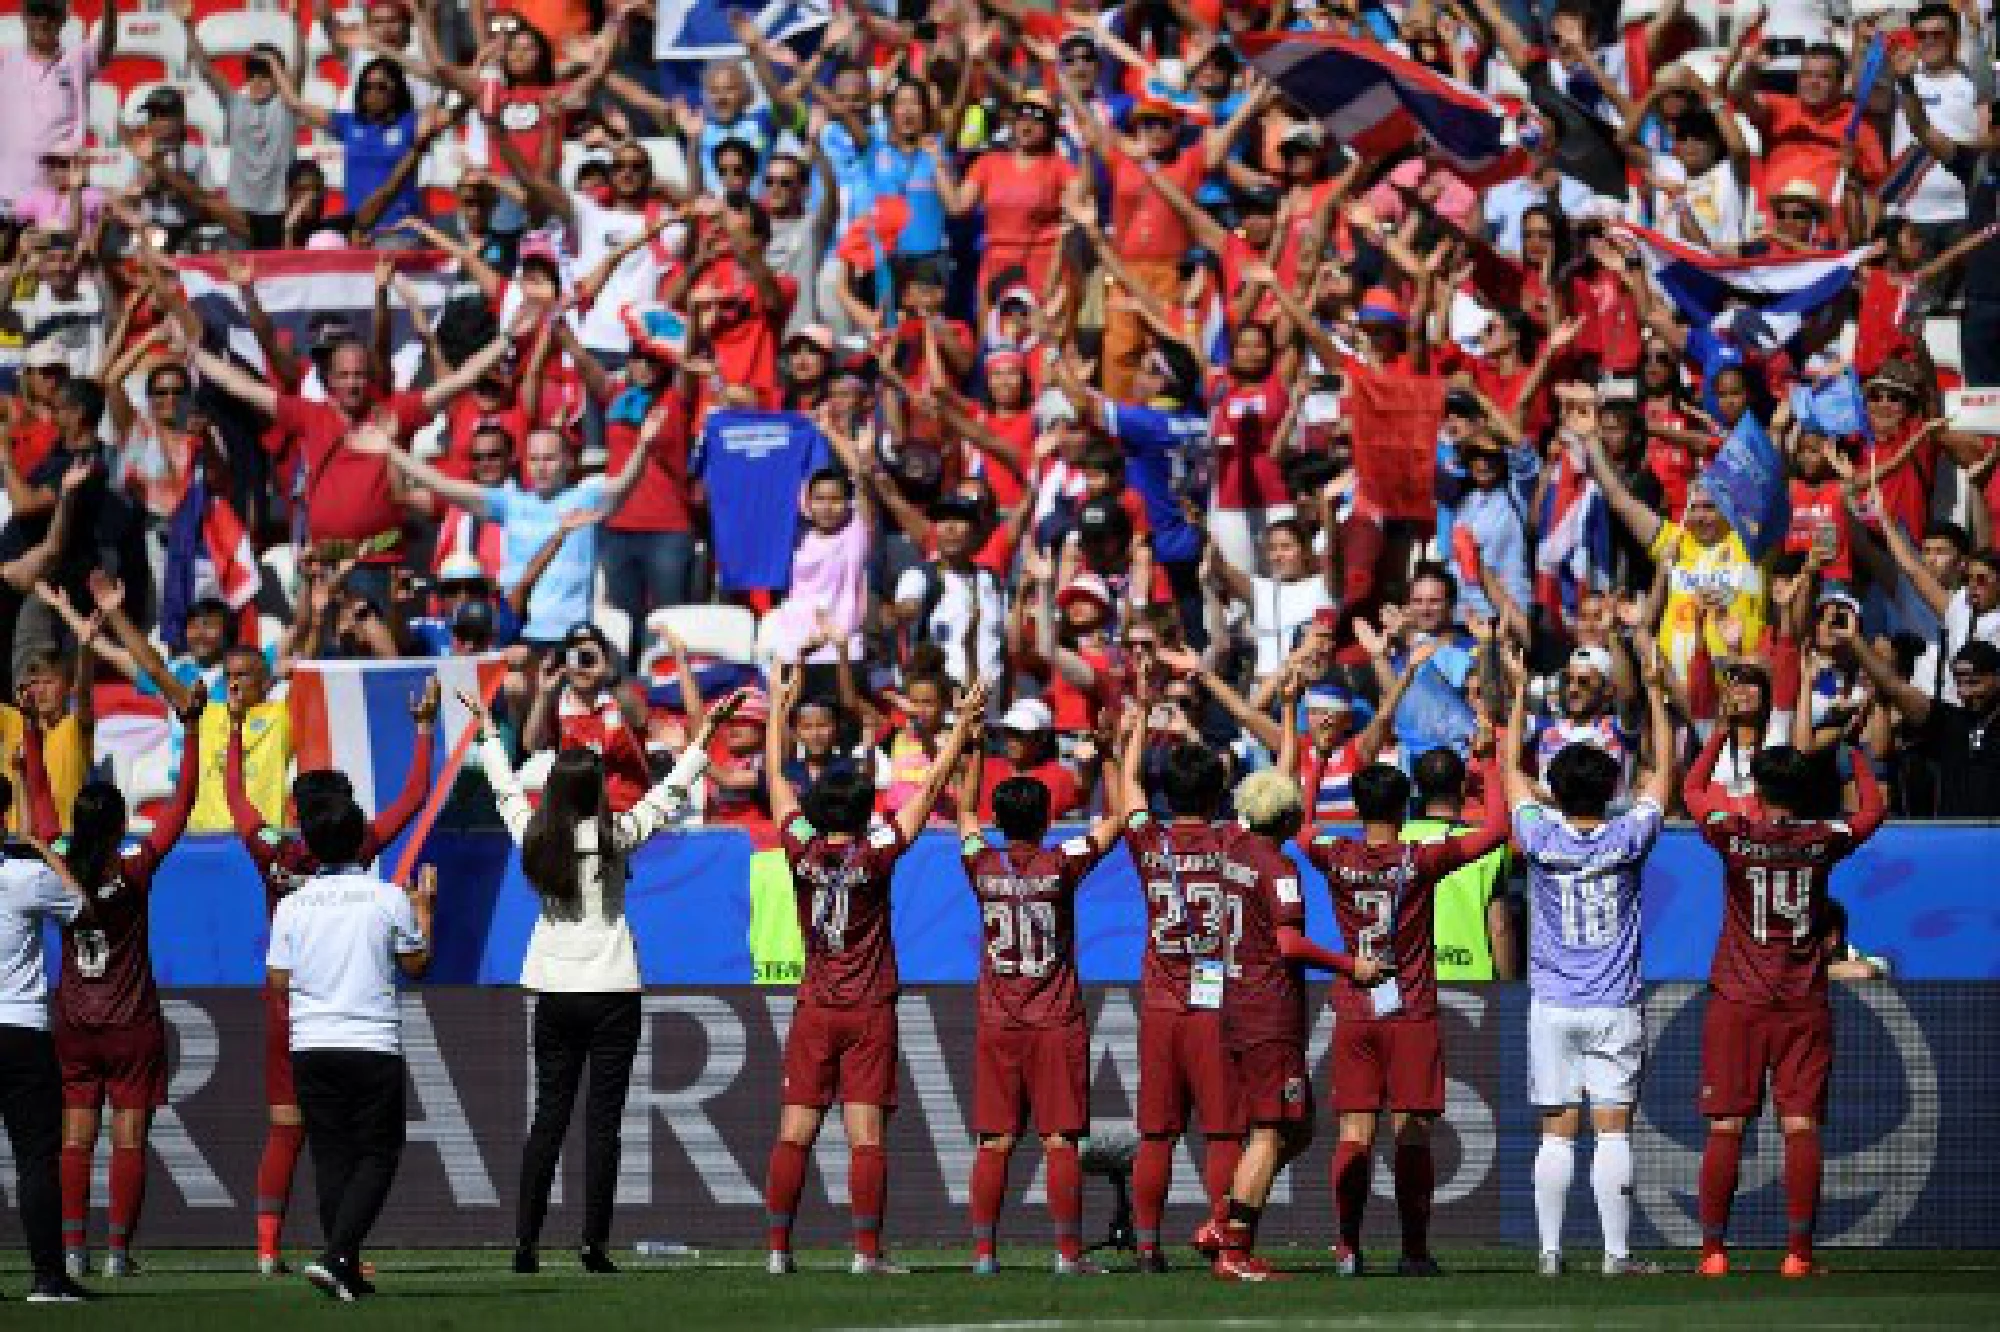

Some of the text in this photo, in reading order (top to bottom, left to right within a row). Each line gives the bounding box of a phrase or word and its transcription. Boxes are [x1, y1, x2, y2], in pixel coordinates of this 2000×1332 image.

[983, 901, 1056, 977] 20
[1147, 883, 1224, 954] 23
[1354, 890, 1392, 960] 2
[1552, 874, 1618, 945] 18
[1746, 867, 1812, 945] 14
[396, 988, 1498, 1208] AIRWAS
